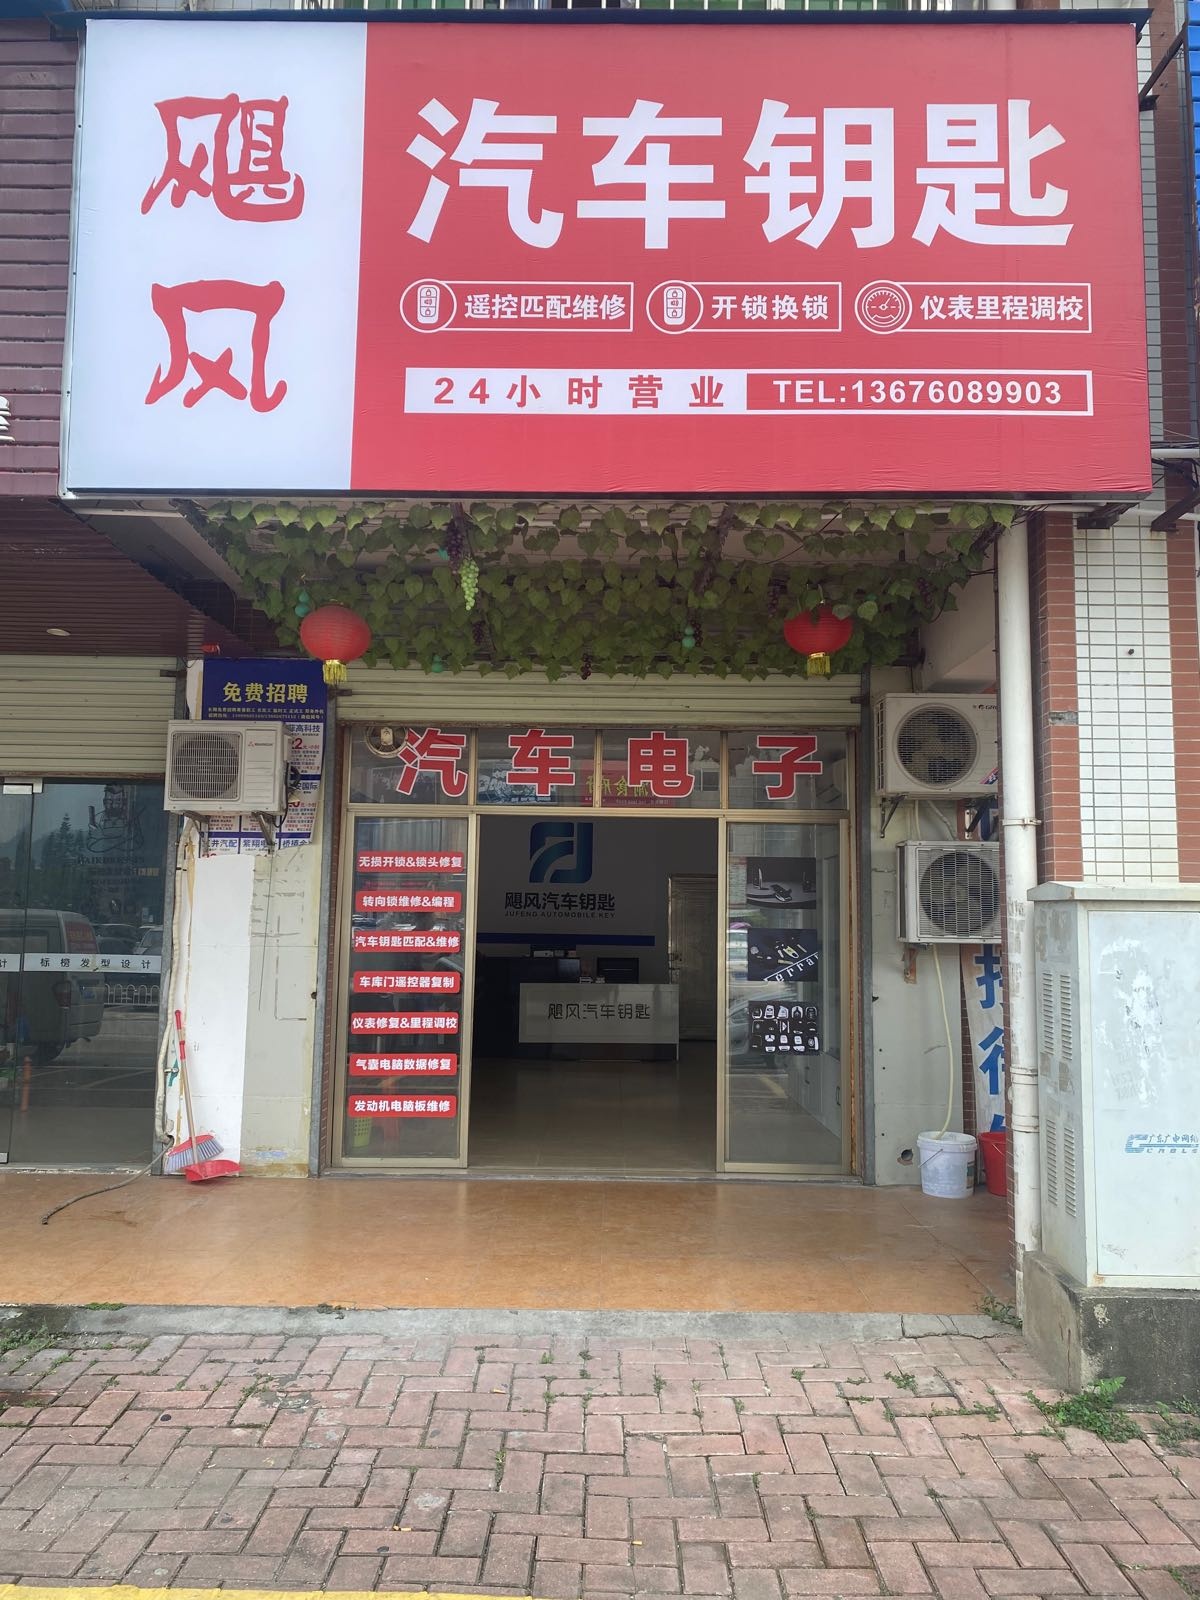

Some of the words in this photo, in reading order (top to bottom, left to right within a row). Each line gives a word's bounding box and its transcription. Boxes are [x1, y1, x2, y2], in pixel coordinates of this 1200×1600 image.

[406, 97, 1074, 250] 汽车钥匙
[141, 93, 305, 413] 飓风
[464, 294, 626, 320] 遥控匹配维修
[712, 294, 829, 320] 开锁换锁
[920, 295, 1084, 321] 仪表里程调校
[434, 375, 724, 409] 24小时营业
[773, 379, 1062, 404] TEL:13676089903
[223, 682, 308, 703] 免费招聘
[396, 728, 822, 800] 汽车电子
[359, 856, 463, 868] 无损开锁&锁头修复
[363, 896, 455, 908] 转向锁维修&编程
[504, 892, 616, 911] 飓风汽车钥匙
[355, 935, 460, 948] 汽车钥匙匹配&维修
[40, 958, 151, 969] 标榜发型设计
[359, 976, 455, 988] 车库门遥控器复制
[548, 1004, 651, 1020] 飓风汽车钥匙
[352, 1017, 458, 1029] 仪表修复&里程调校
[356, 1058, 451, 1071] 气囊电脑数据修复
[354, 1099, 450, 1112] 发动机电脑板维修
